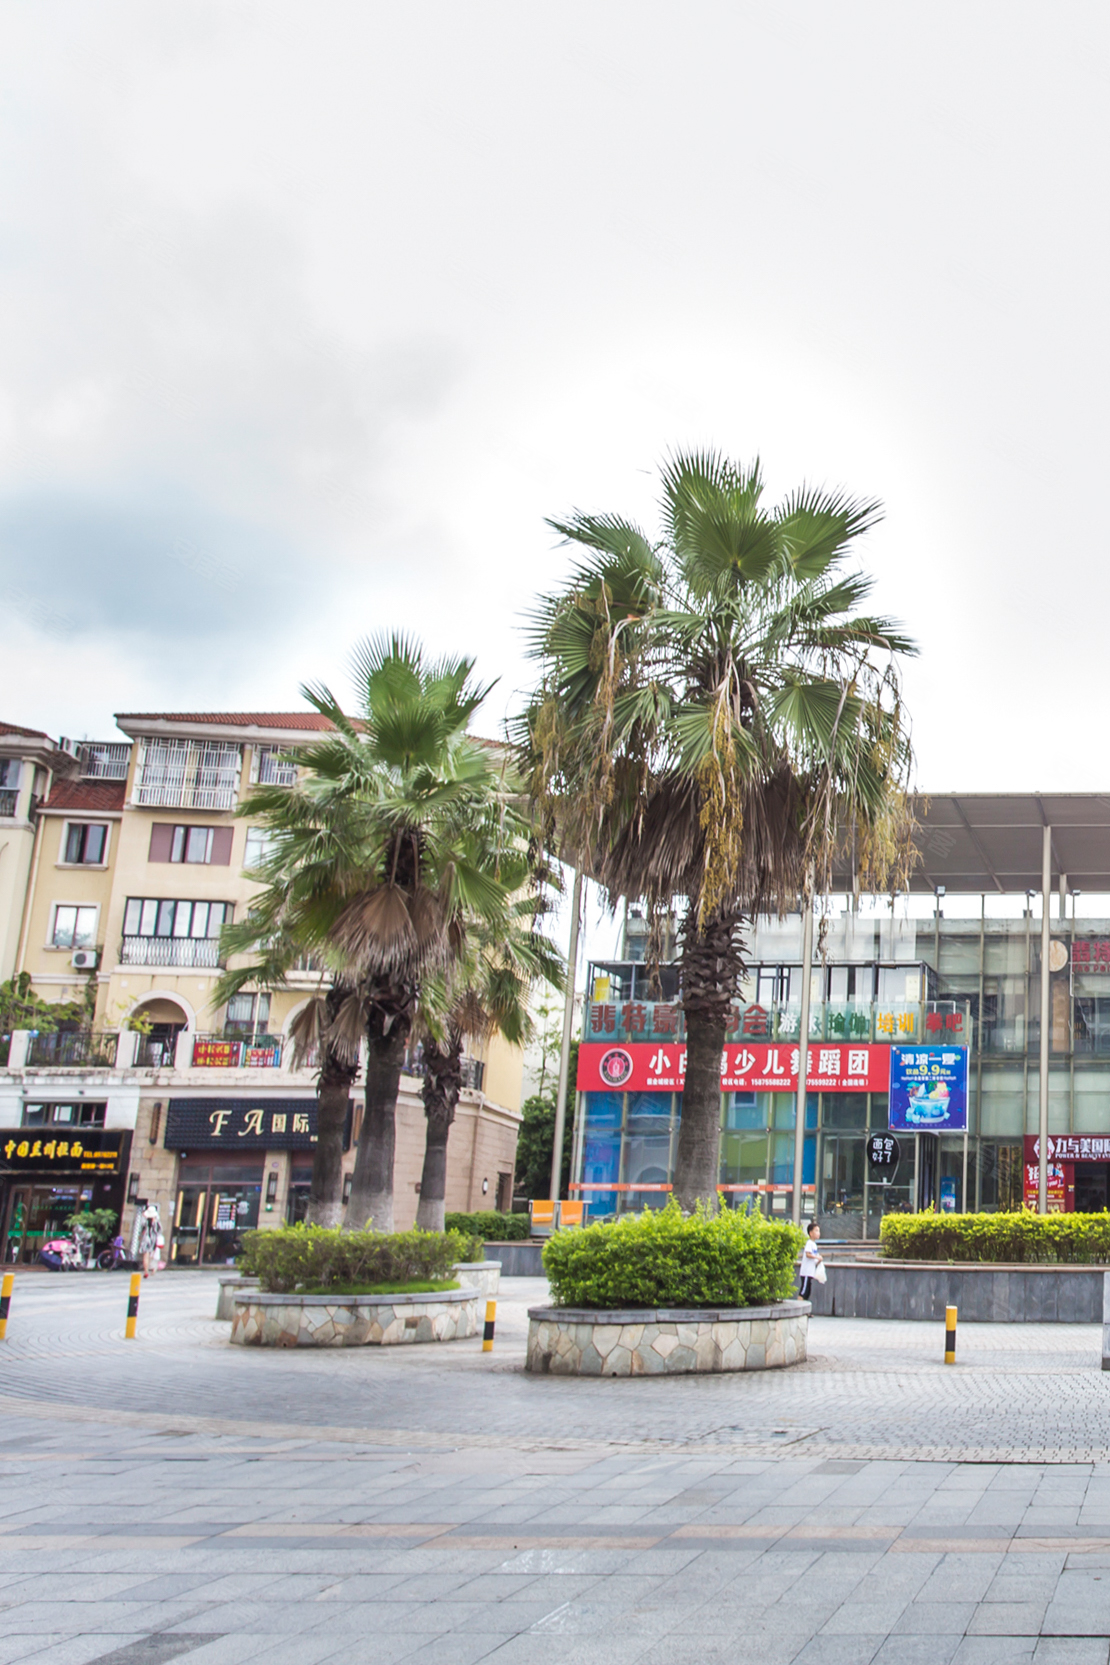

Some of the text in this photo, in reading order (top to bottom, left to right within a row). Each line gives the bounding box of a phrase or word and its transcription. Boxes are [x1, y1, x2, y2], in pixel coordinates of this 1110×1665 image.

[876, 1012, 914, 1034] 培训
[648, 1048, 869, 1076] 小少儿舞蹈团
[901, 1053, 956, 1065] 清凉一夏
[4, 1139, 84, 1159] 中国兰州拉面
[872, 1137, 894, 1150] 面包
[872, 1150, 892, 1164] 好了
